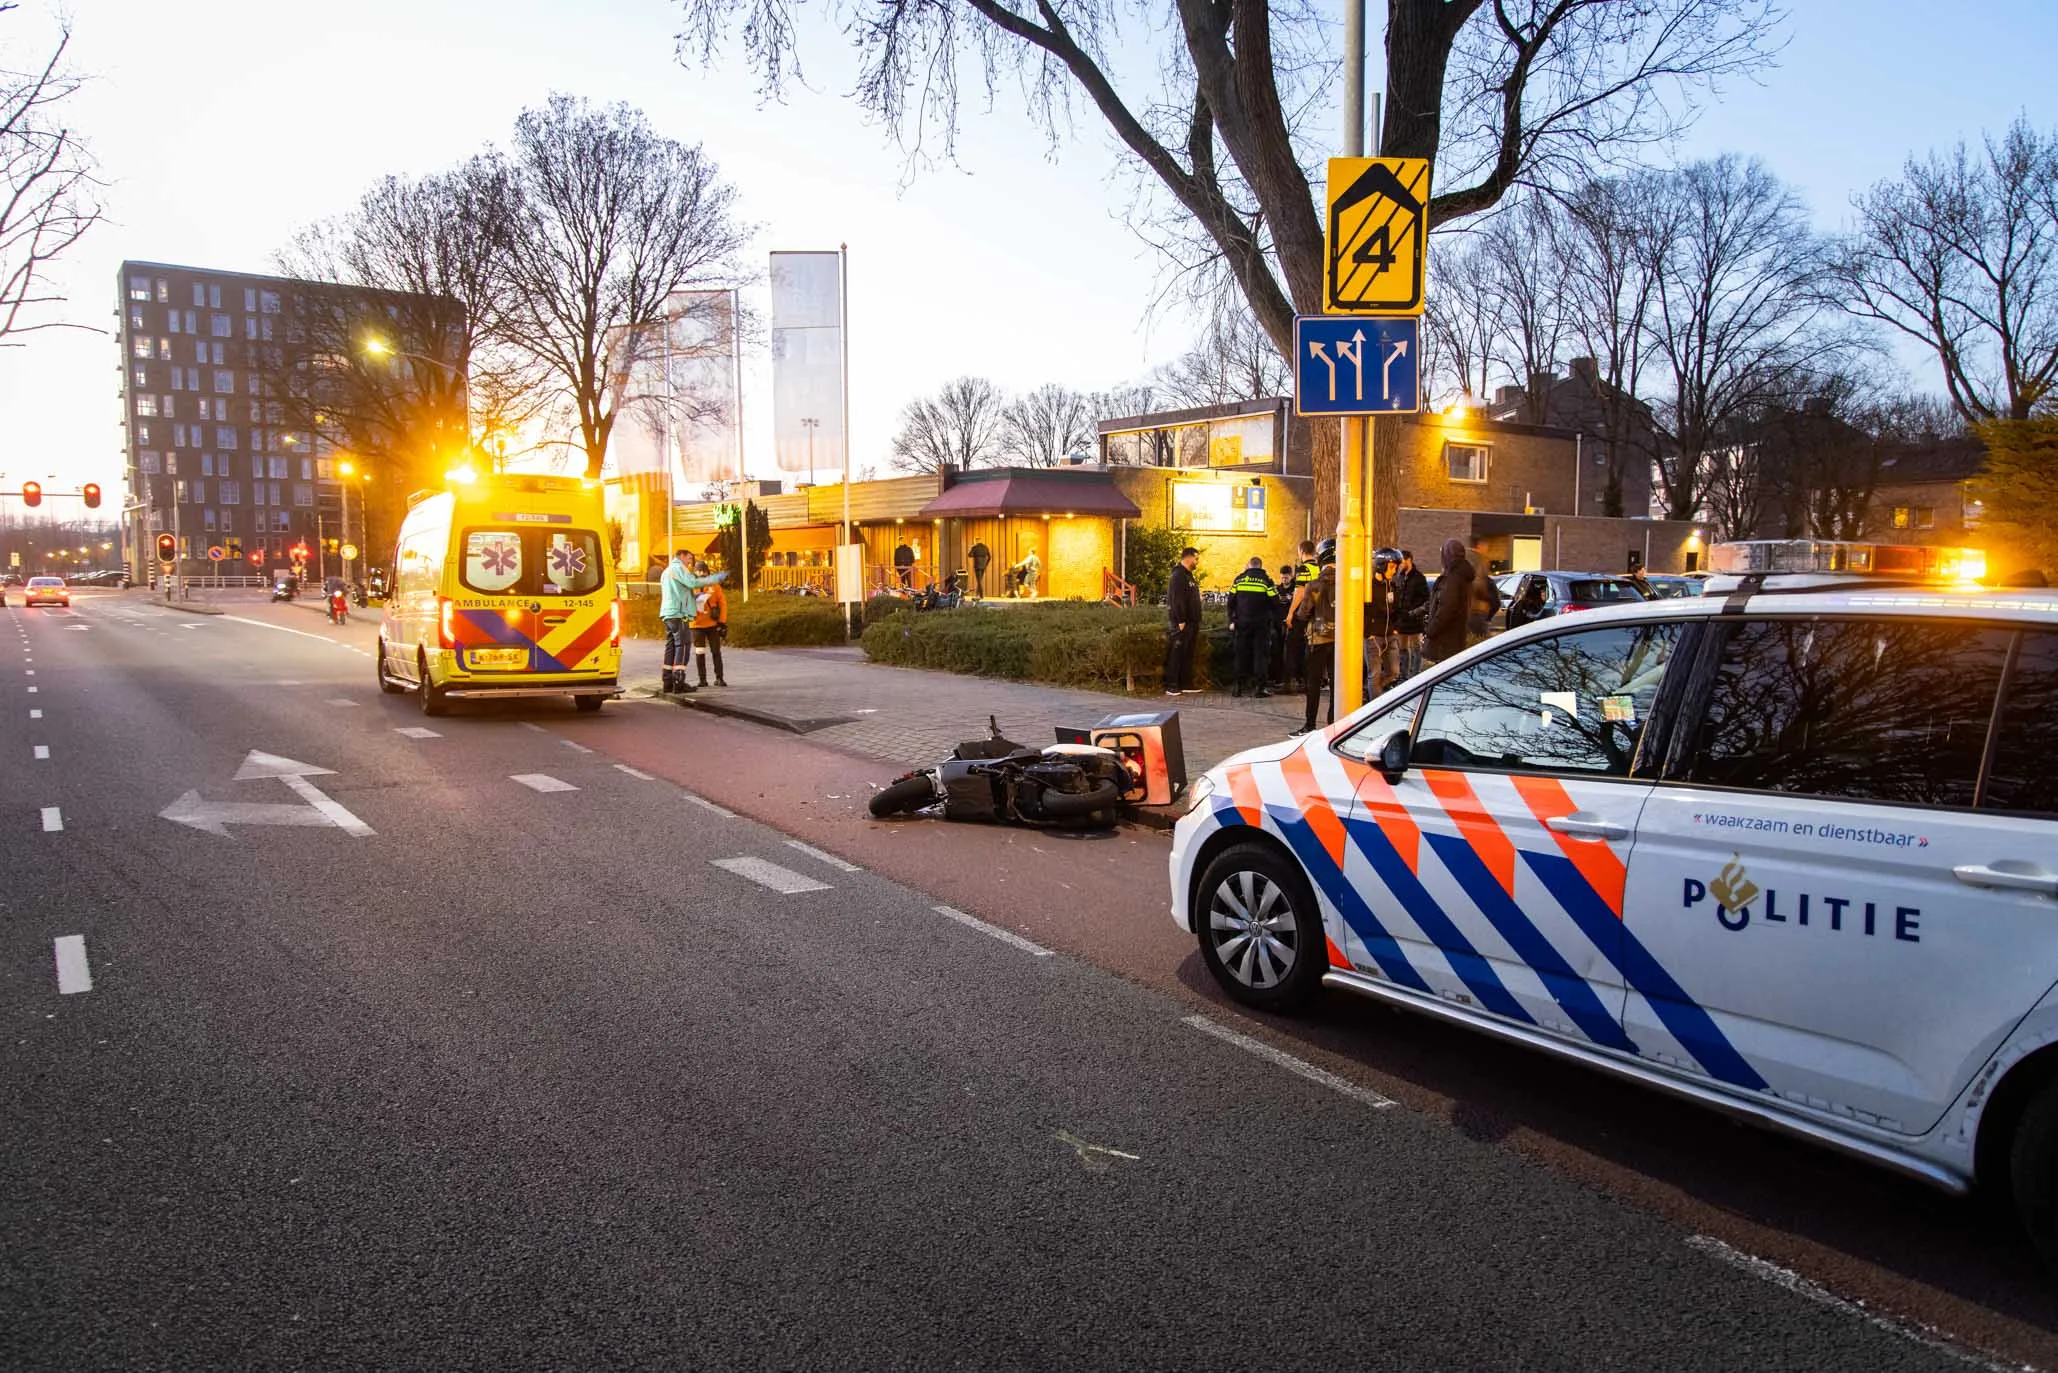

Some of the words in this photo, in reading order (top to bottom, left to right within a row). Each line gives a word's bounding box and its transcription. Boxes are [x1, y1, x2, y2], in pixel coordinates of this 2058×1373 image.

[1352, 225, 1396, 272] 4
[563, 599, 594, 608] 12-145
[1704, 813, 1789, 833] waakzaam
[1793, 823, 1814, 836] en
[1818, 823, 1915, 847] dienstbaar
[1683, 878, 1920, 942] POLITIE
